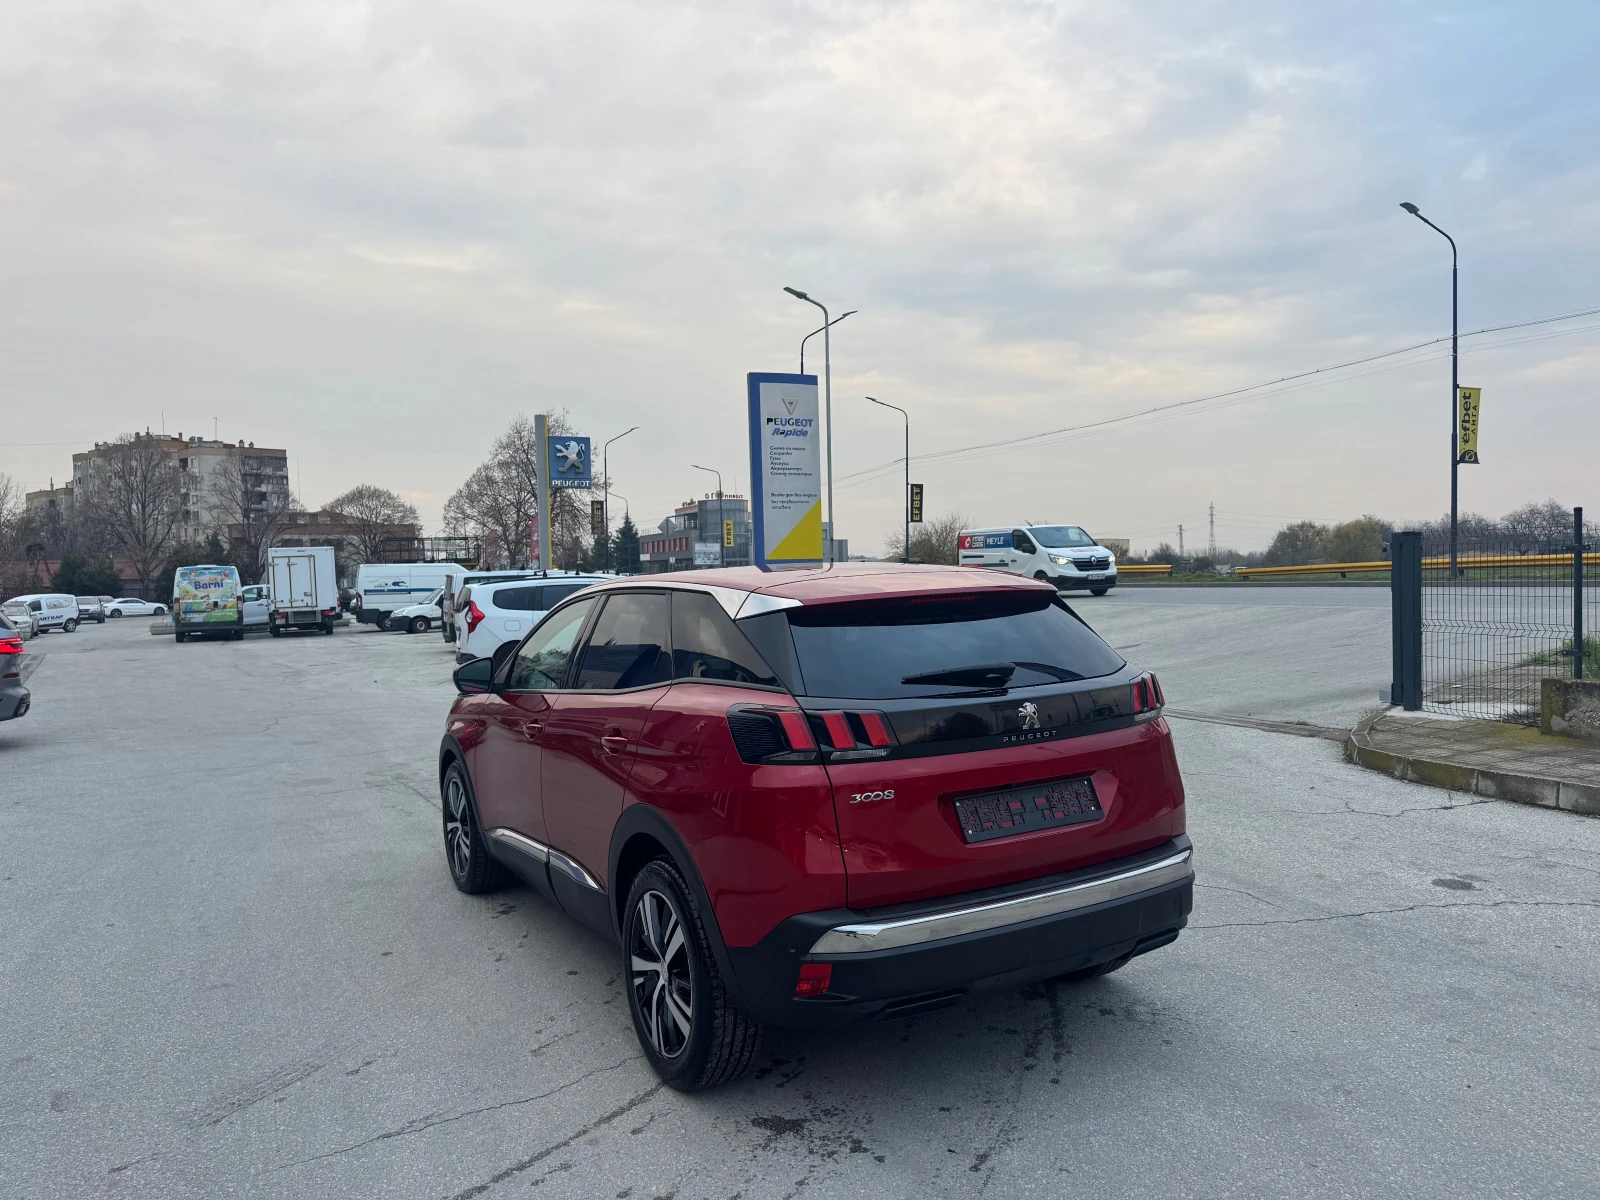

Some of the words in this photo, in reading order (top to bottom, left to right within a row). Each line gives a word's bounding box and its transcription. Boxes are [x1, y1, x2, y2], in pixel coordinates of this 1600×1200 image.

[766, 418, 813, 427] PEUGEOT
[1461, 392, 1471, 445] efbet
[772, 428, 809, 437] Rapide
[986, 537, 1004, 545] MEYLE
[194, 580, 224, 589] Barni
[1003, 730, 1057, 742] PEUGEOT
[849, 789, 895, 804] 3008
